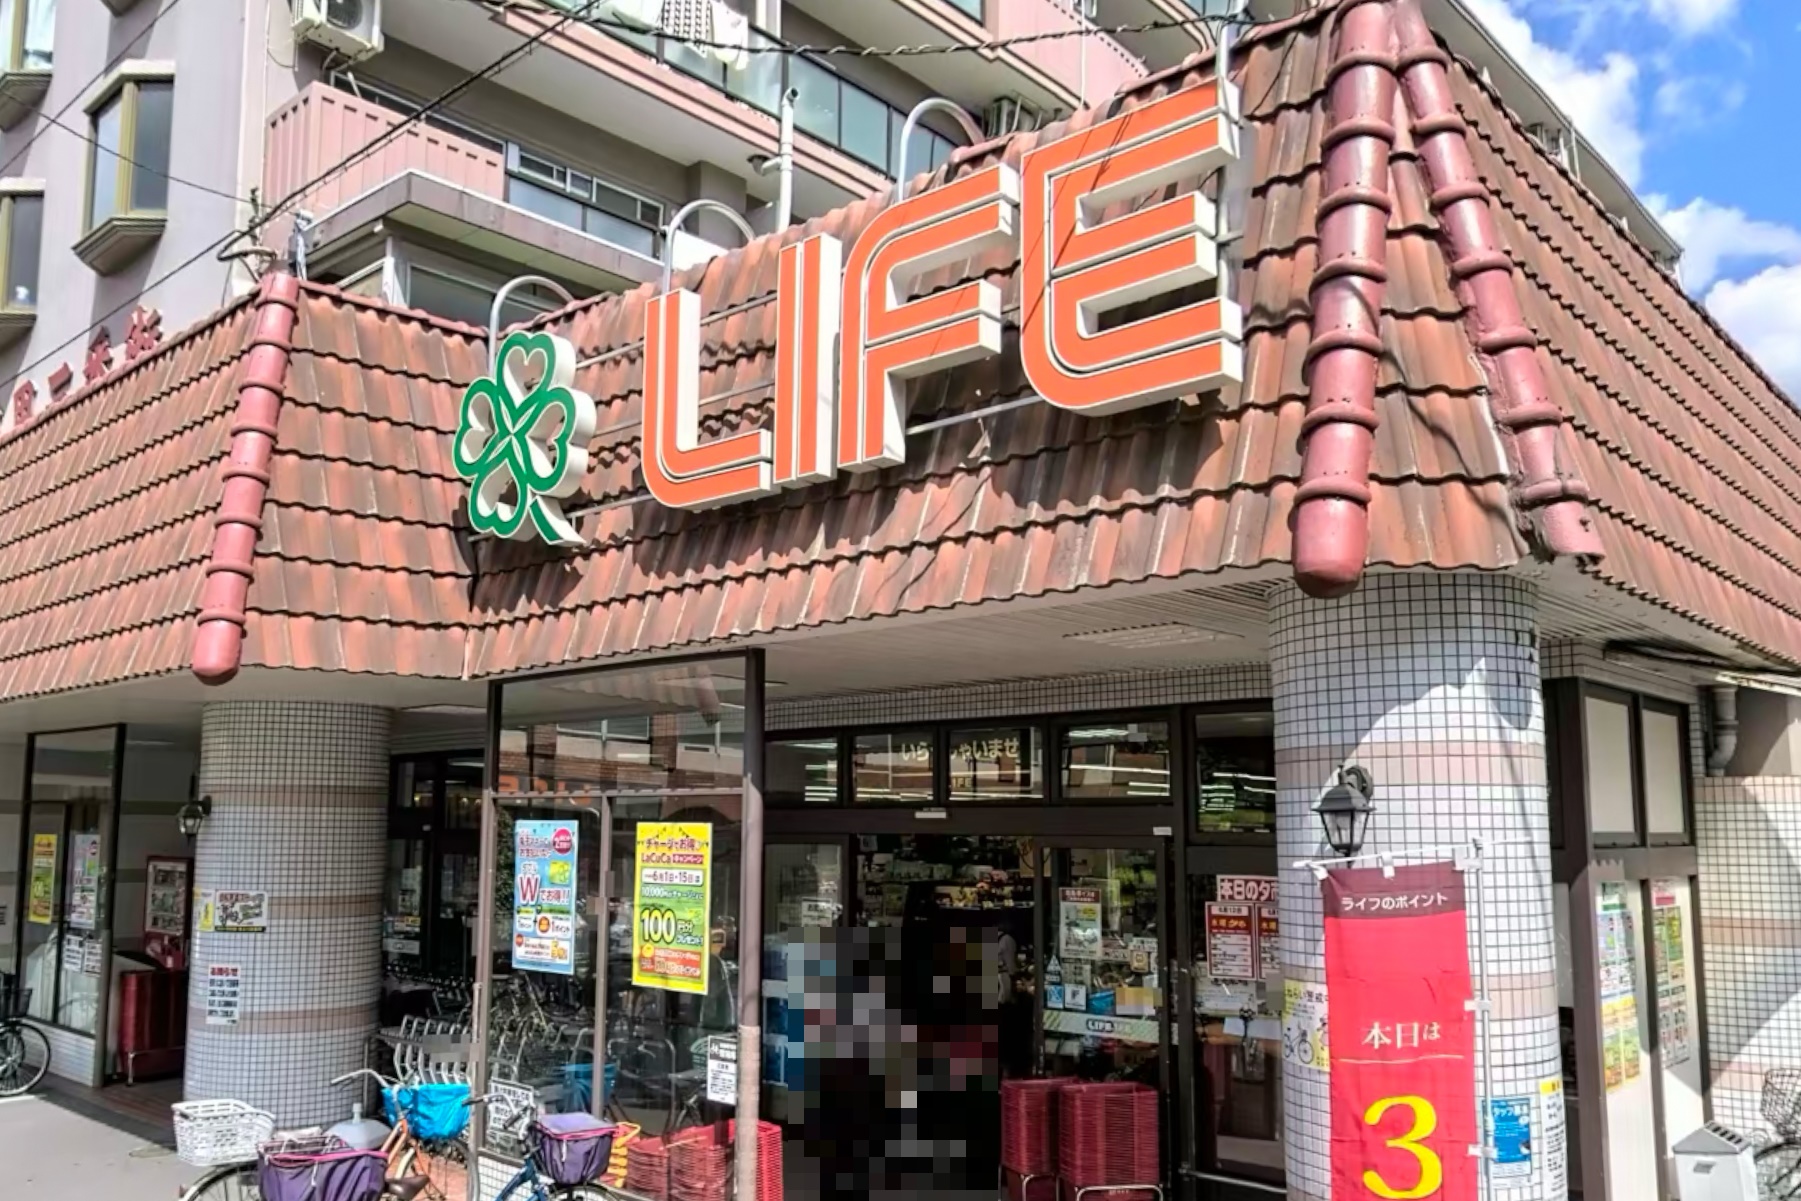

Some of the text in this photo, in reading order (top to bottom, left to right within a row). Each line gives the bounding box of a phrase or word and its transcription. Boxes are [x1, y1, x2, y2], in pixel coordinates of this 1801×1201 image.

[642, 75, 1243, 511] LIFE
[1341, 892, 1448, 912] ライフのポイント
[640, 907, 677, 945] 100
[1361, 1020, 1442, 1050] 本日は
[1362, 1095, 1443, 1200] 3
